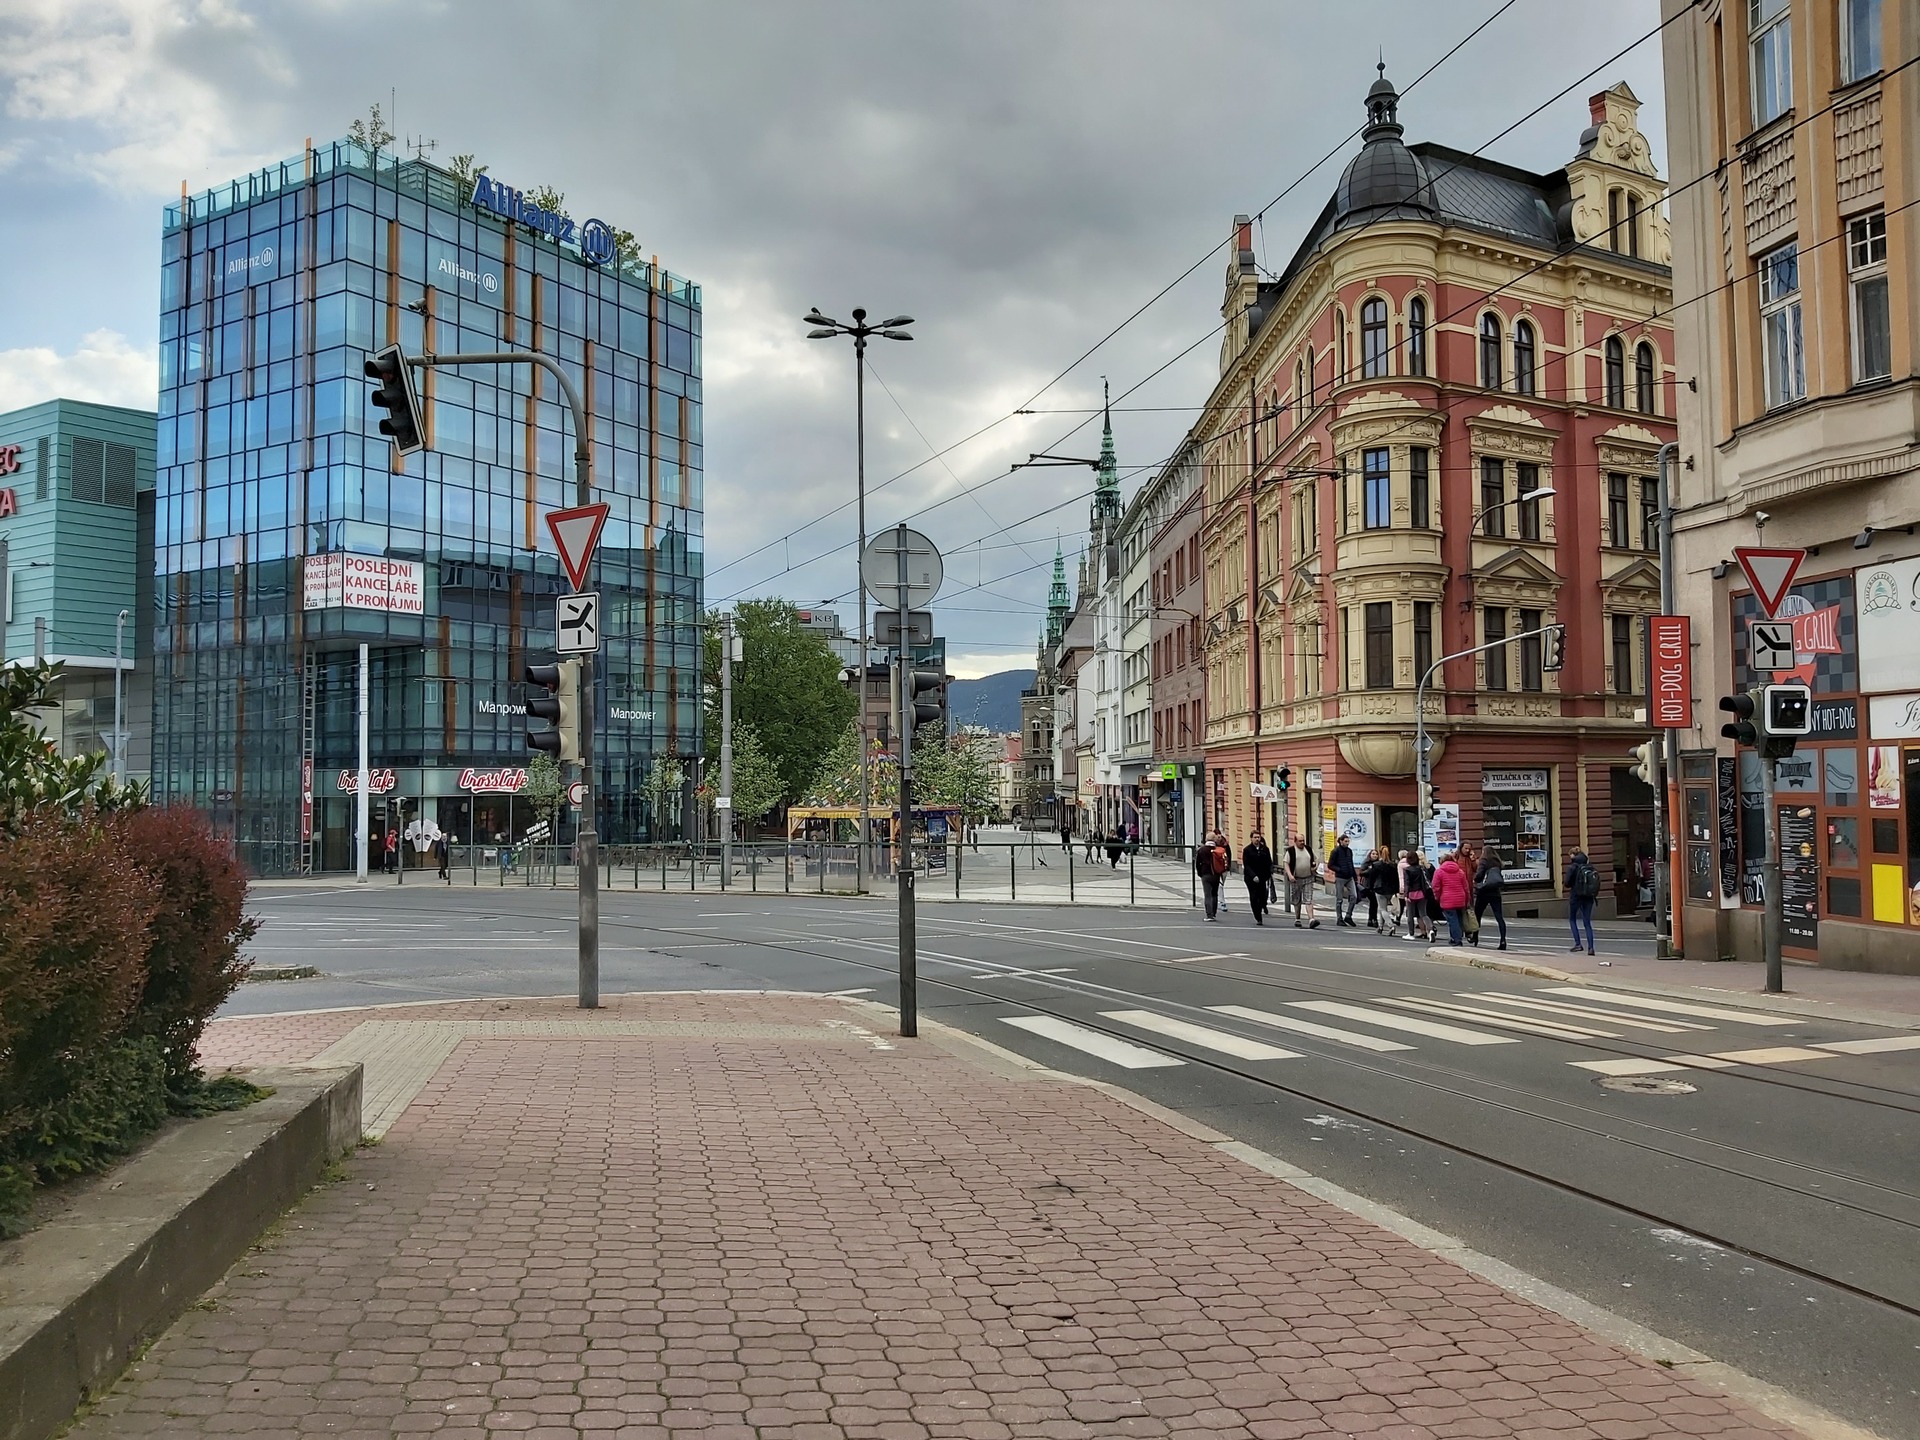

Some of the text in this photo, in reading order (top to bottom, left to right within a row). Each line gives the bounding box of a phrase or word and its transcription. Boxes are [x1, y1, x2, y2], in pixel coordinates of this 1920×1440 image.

[470, 174, 575, 244] Allianz
[228, 255, 260, 275] Allianz
[438, 257, 481, 285] Allianz
[305, 554, 341, 568] POSLEDNÍ
[345, 557, 413, 578] POSLEDNÍ
[345, 575, 418, 595] KANCELÁŘE
[345, 592, 423, 611] K PRONÁJMU
[1804, 609, 1836, 650] GRILL
[1658, 623, 1683, 722] HOT-DOG GRILL
[610, 707, 657, 720] Manpower
[1822, 706, 1856, 731] HOT-DOG
[459, 769, 529, 794] CrossCafe
[1491, 772, 1532, 781] TULAČKA CK
